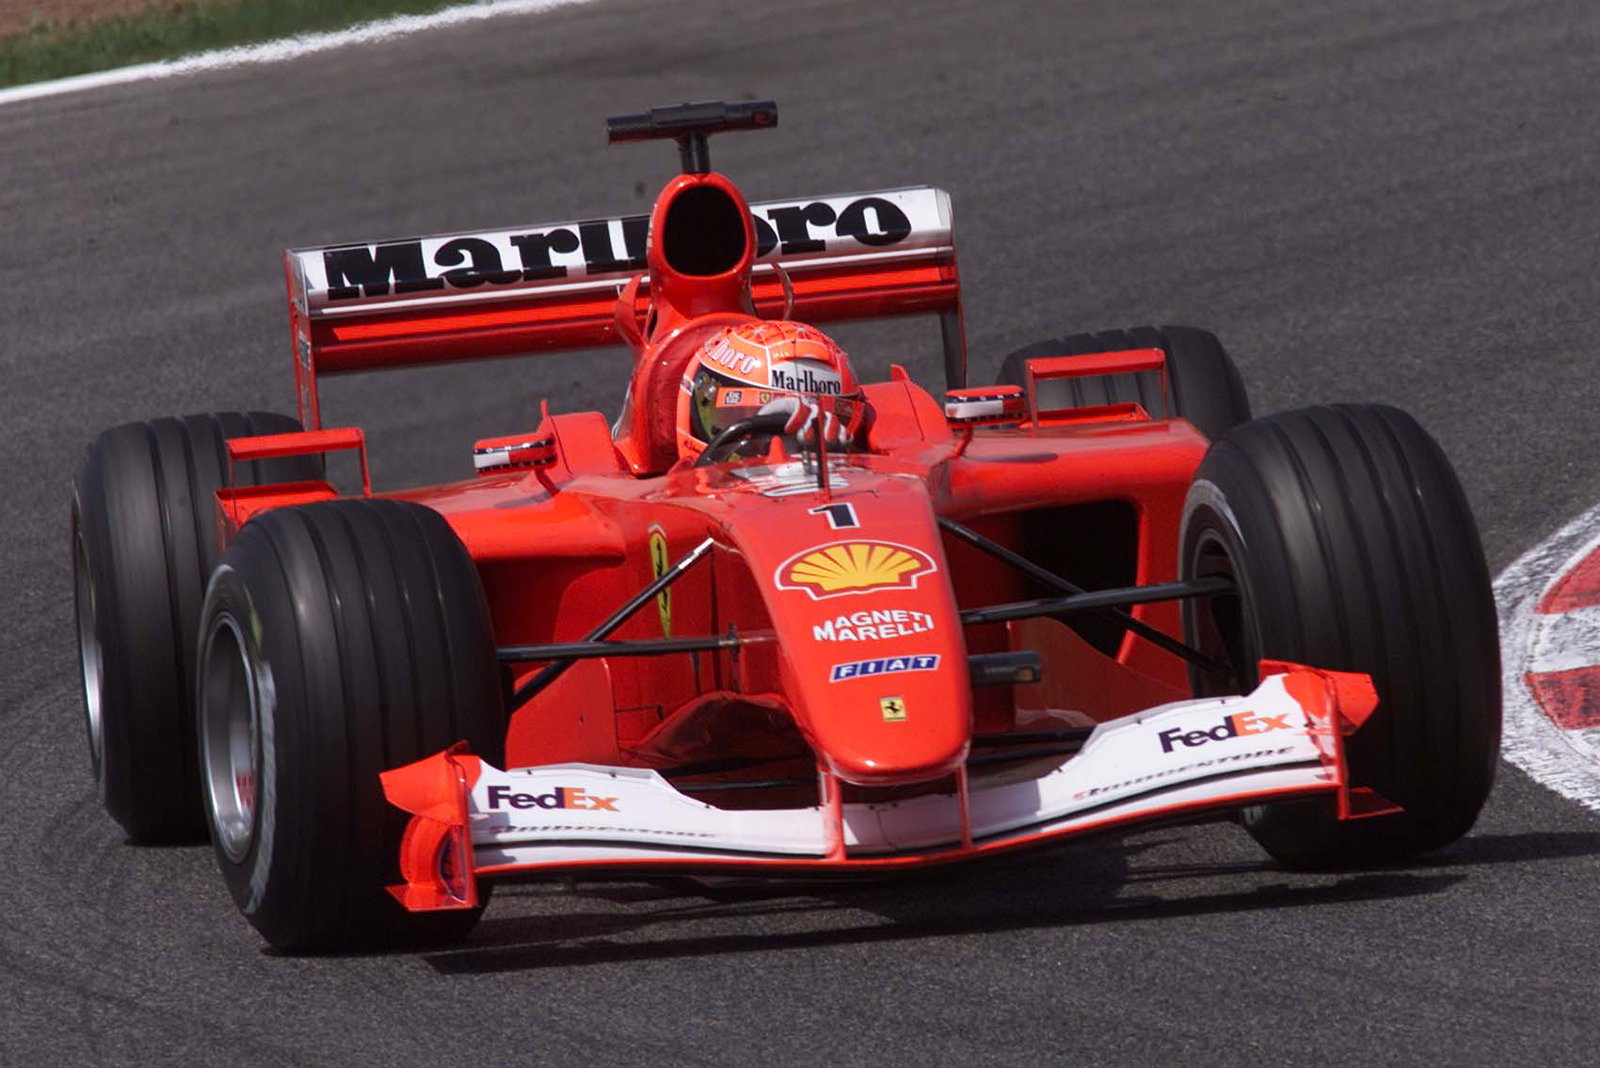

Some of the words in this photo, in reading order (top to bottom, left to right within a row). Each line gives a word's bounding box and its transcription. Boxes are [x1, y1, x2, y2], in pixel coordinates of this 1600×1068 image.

[771, 369, 841, 395] Marlboro
[808, 502, 861, 530] 1
[812, 609, 934, 641] MAGNETI
[812, 614, 934, 641] MARELLI
[838, 657, 934, 678] FIAT
[1157, 711, 1294, 753] FedEx
[487, 785, 620, 812] FedEx
